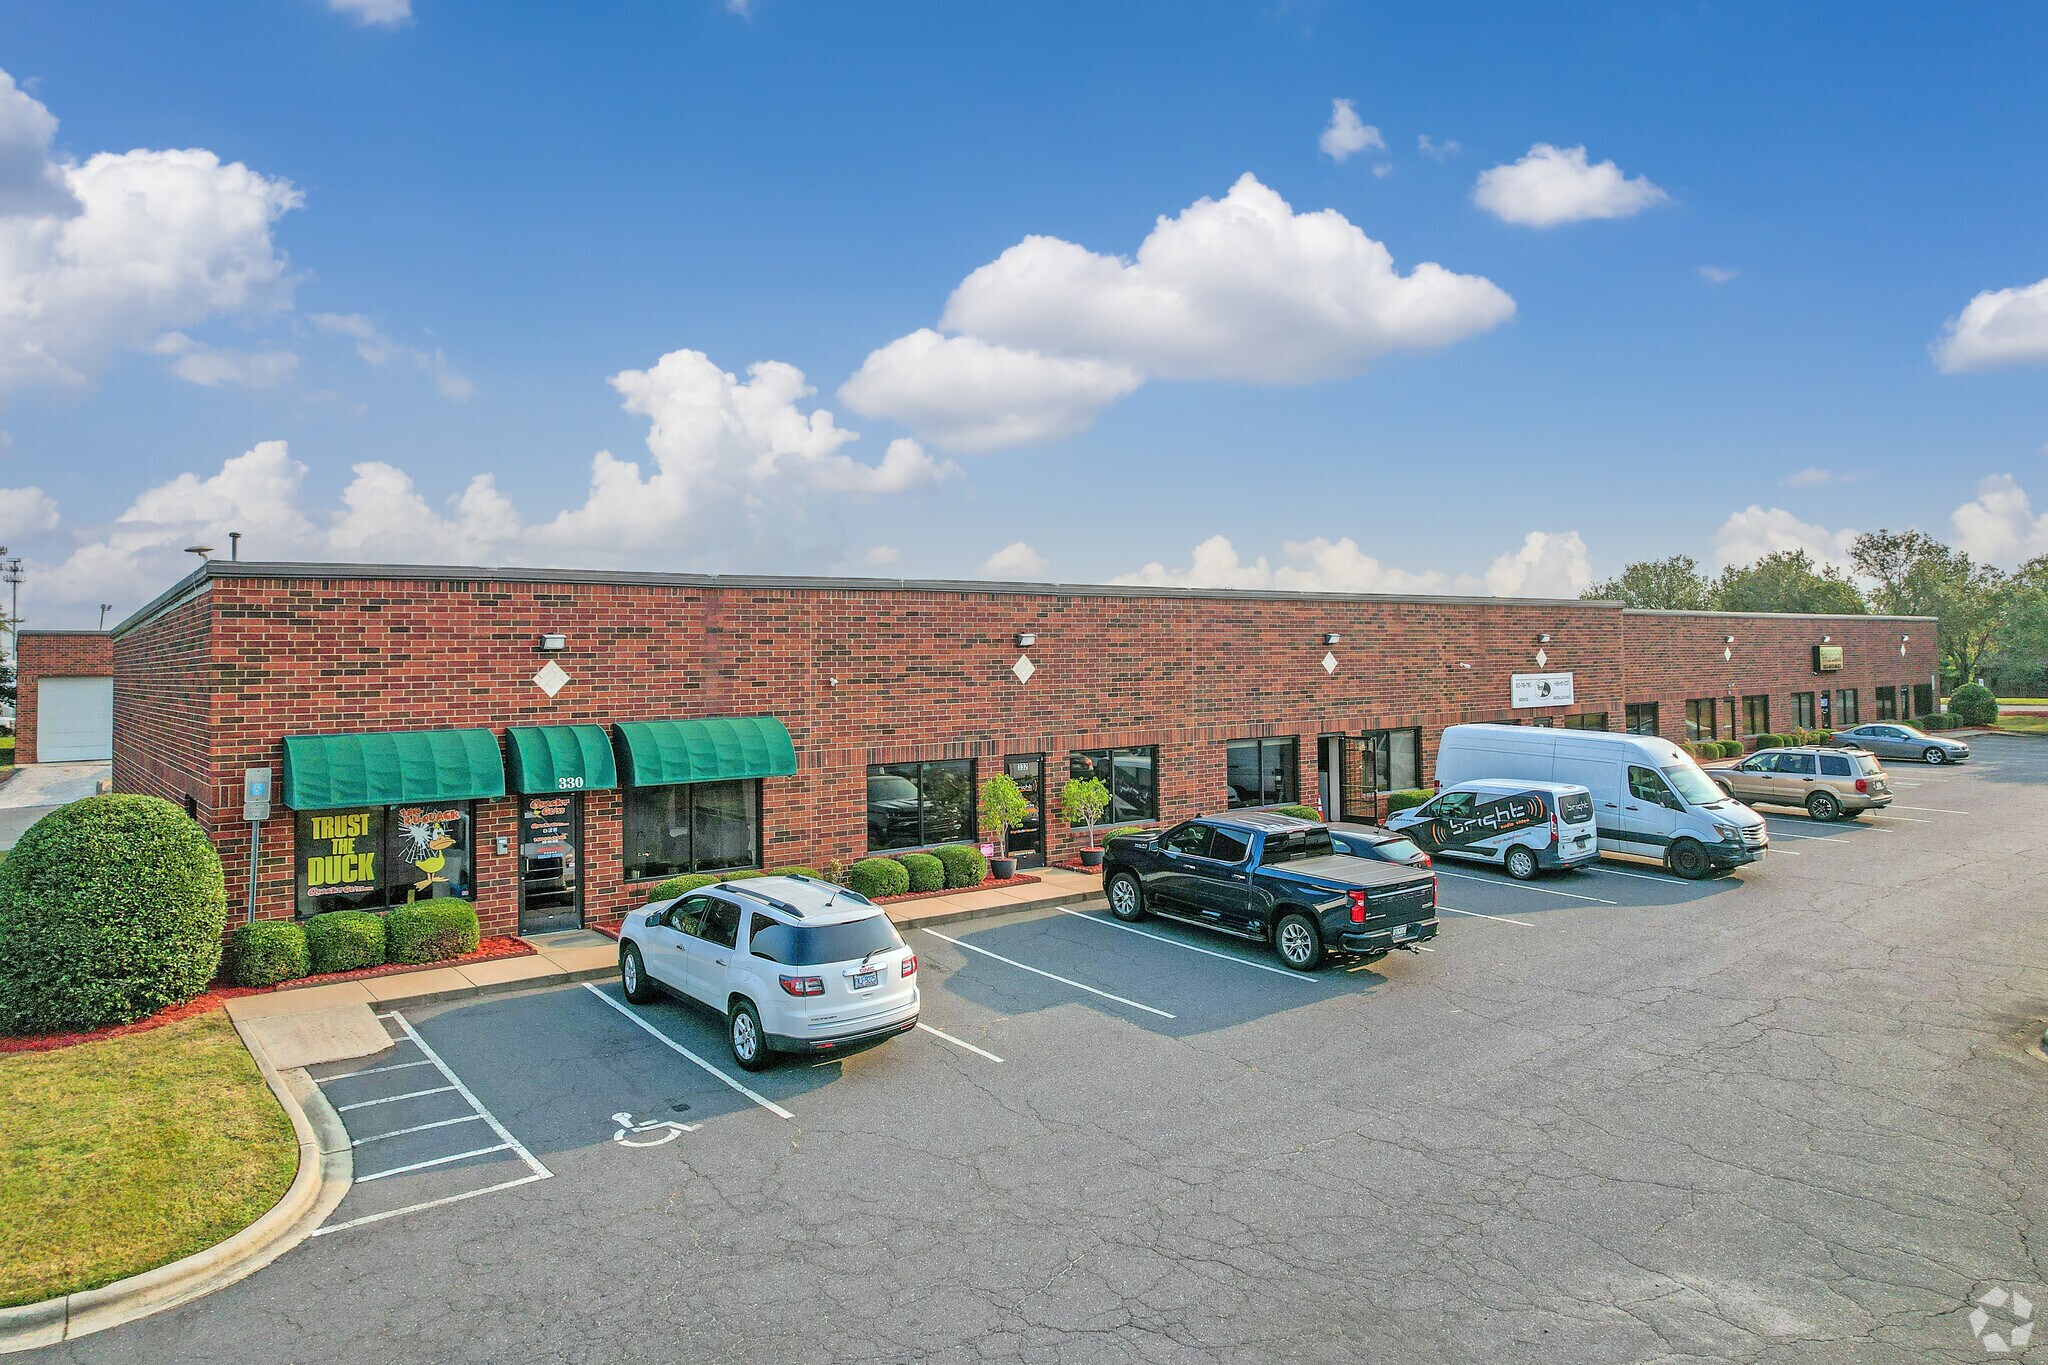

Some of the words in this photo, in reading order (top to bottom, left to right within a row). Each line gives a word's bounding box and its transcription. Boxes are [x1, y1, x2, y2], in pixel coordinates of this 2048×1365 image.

[558, 776, 584, 789] 330
[311, 813, 370, 840] TRUST
[1449, 802, 1526, 835] bright
[331, 837, 356, 855] THE
[307, 852, 375, 886] DUCK
[860, 966, 876, 974] GMC
